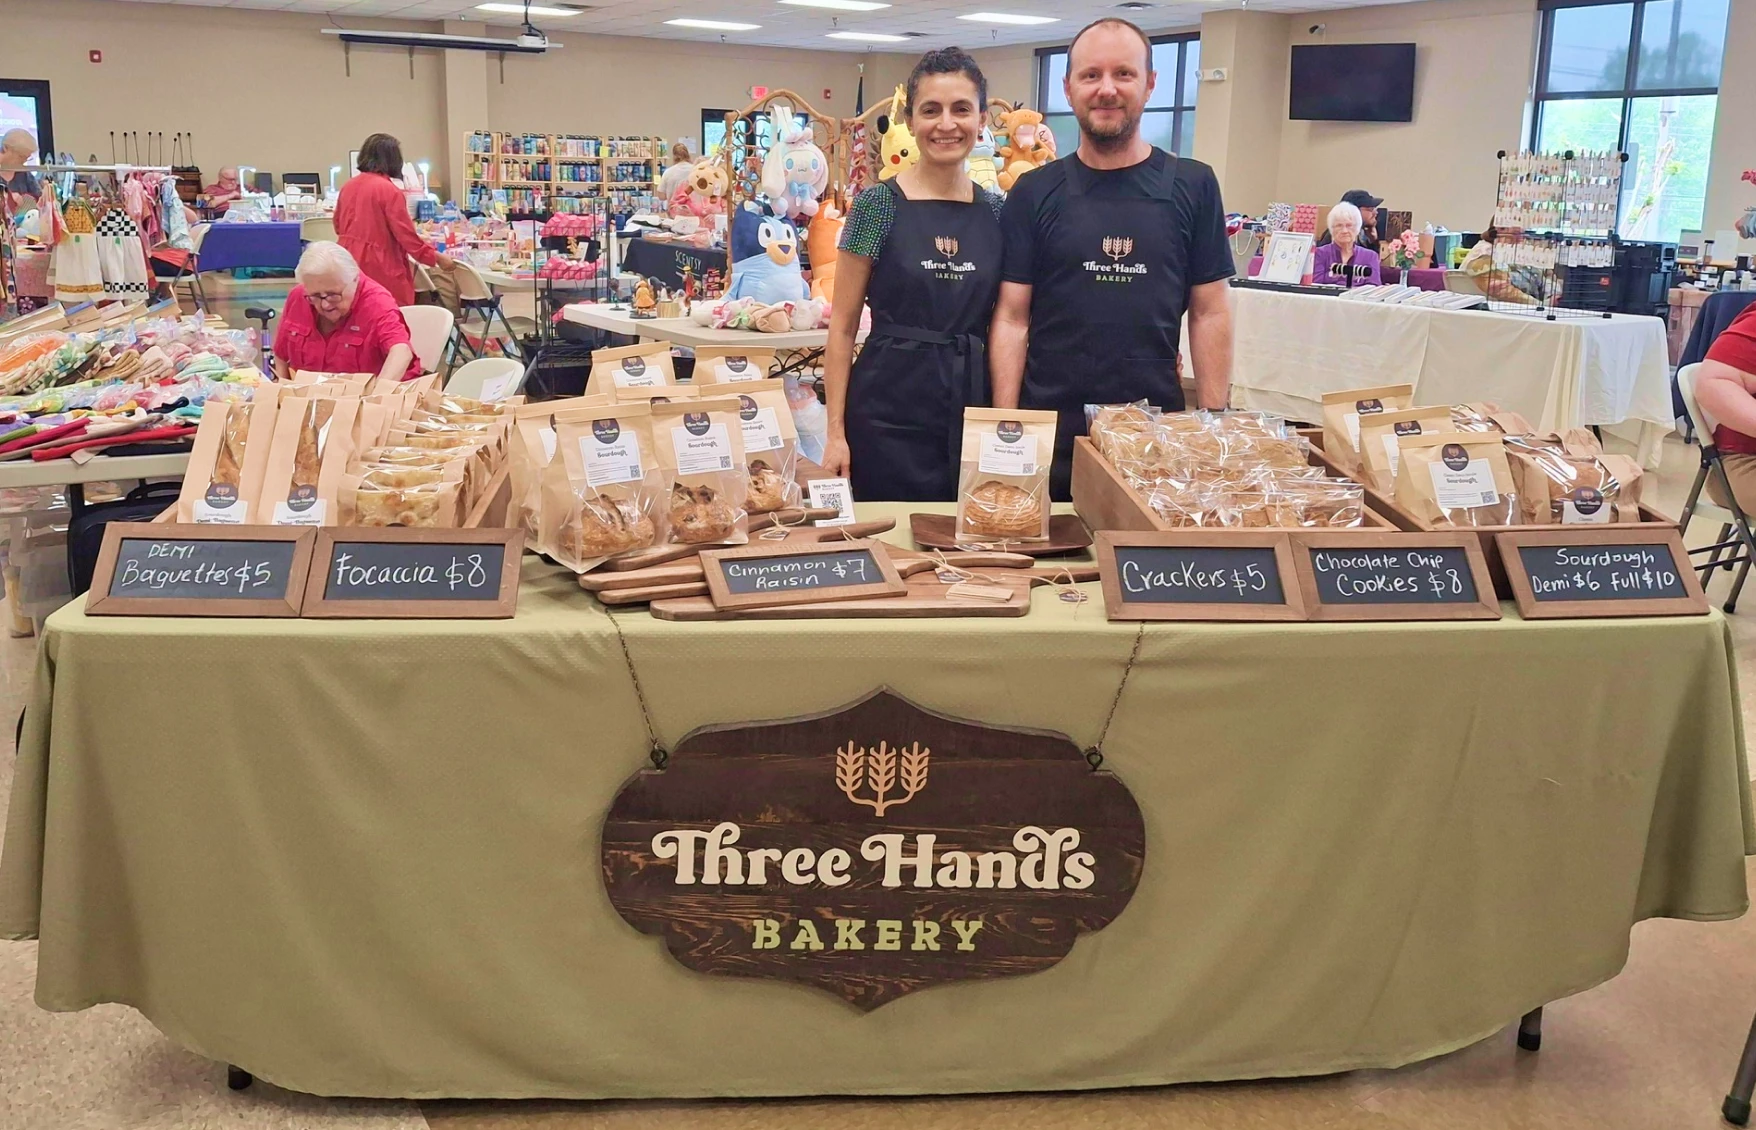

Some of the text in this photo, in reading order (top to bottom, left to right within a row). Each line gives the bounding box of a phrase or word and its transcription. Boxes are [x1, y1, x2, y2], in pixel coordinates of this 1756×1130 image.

[675, 250, 702, 271] SCENTSY
[920, 259, 947, 269] Three
[1082, 260, 1148, 274] Three Hands
[1095, 274, 1133, 283] BAKERY
[596, 449, 629, 458] Sourdough
[148, 543, 195, 560] DEMI
[1315, 552, 1443, 572] Chocolate Chip
[1555, 548, 1655, 568] Sourdough
[121, 559, 271, 593] Baguettes $5
[335, 552, 486, 591] Focaccia $8
[728, 558, 866, 581] Cinnamon $7
[1230, 562, 1266, 596] $5
[1532, 567, 1676, 593] Demi $6 Full $10
[755, 574, 819, 590] Raisin
[1336, 568, 1462, 598] Cookies $8
[650, 821, 1097, 890] Three Hands
[751, 918, 985, 952] BAKERY
